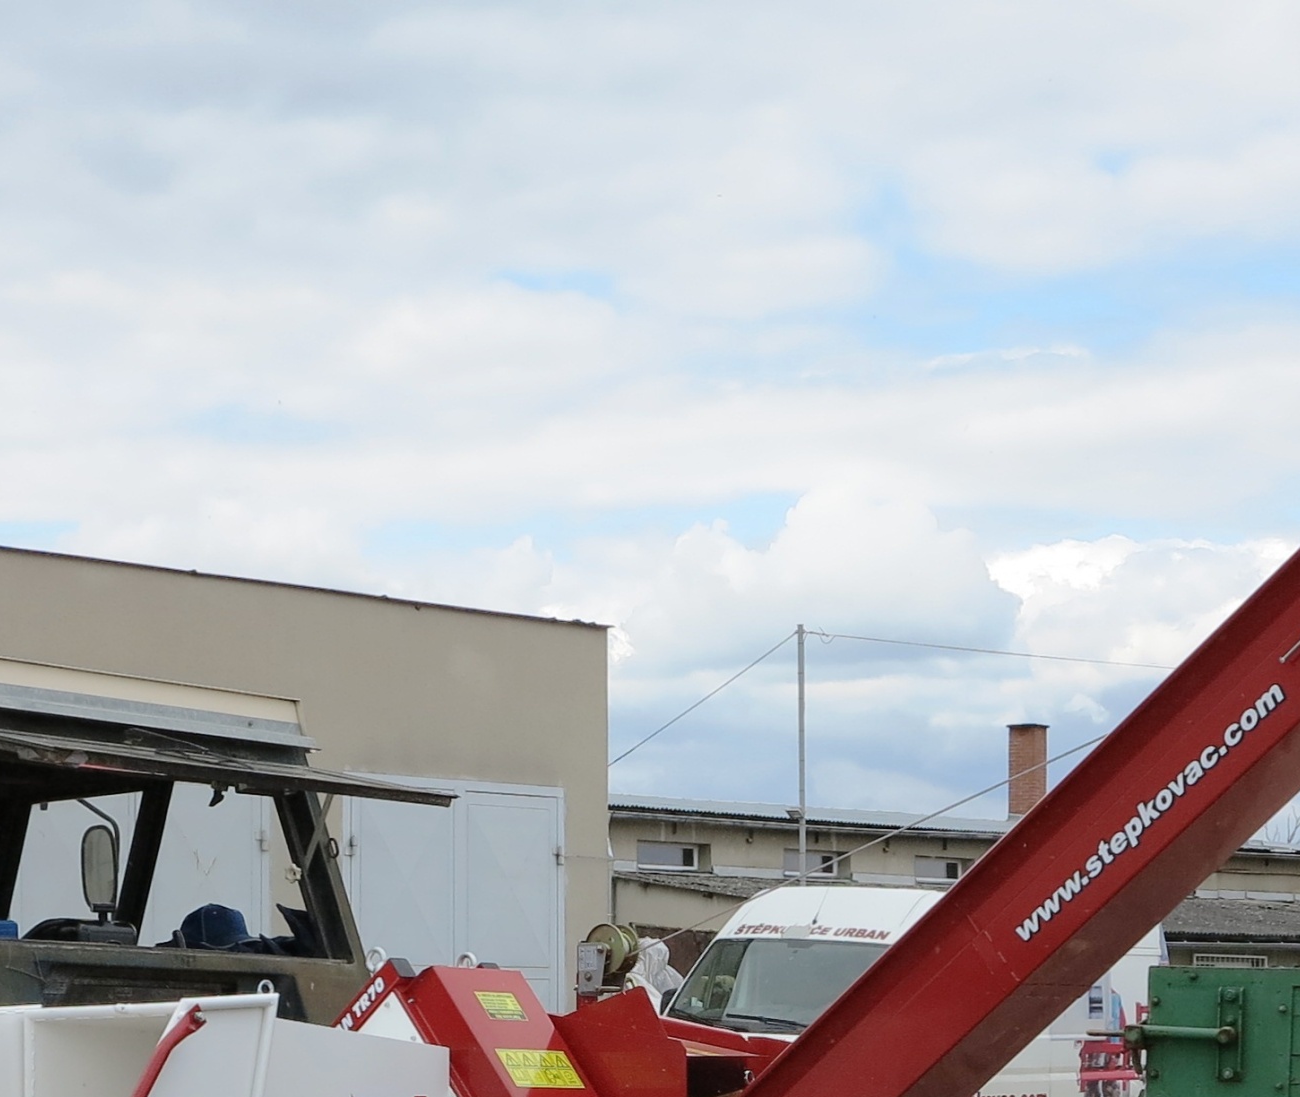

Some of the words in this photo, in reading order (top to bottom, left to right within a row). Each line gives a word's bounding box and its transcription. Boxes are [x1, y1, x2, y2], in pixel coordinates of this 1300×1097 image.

[1015, 683, 1285, 942] www.stepkovac.com
[833, 926, 891, 941] URBAN
[351, 976, 385, 1018] TR70
